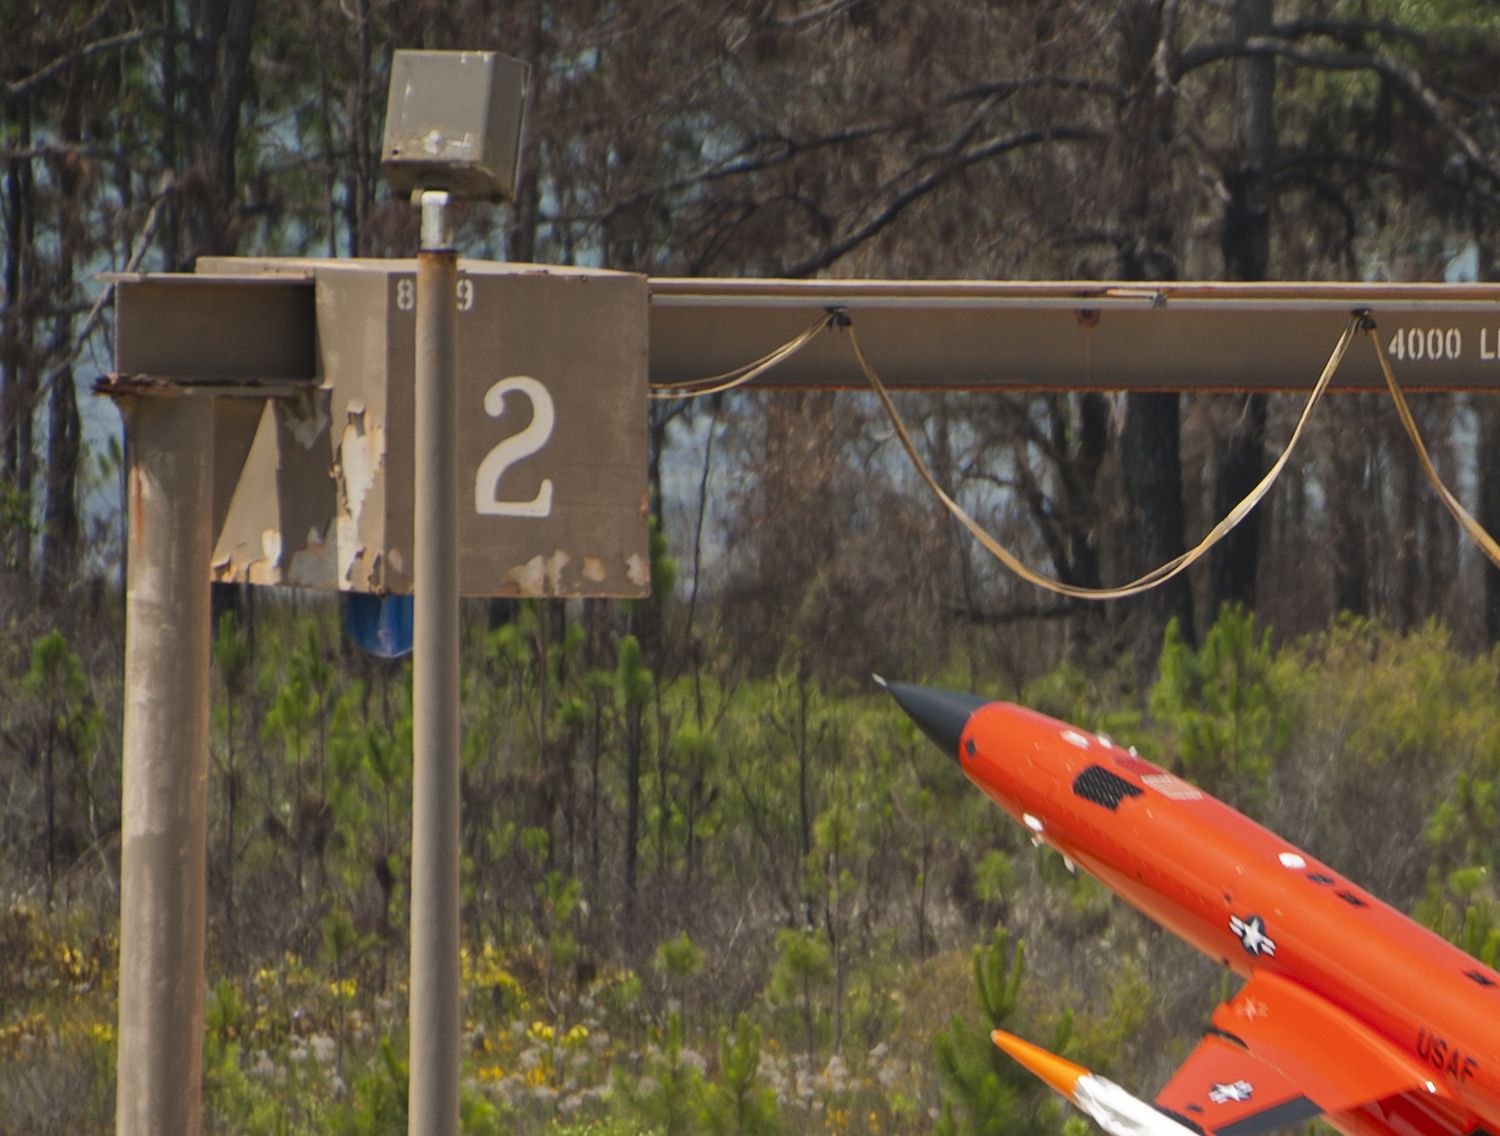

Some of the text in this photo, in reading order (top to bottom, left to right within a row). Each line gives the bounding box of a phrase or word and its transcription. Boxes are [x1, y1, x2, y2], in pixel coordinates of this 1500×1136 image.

[1389, 328, 1461, 360] 4000
[476, 376, 554, 516] 2
[1417, 1029, 1478, 1084] USAF
